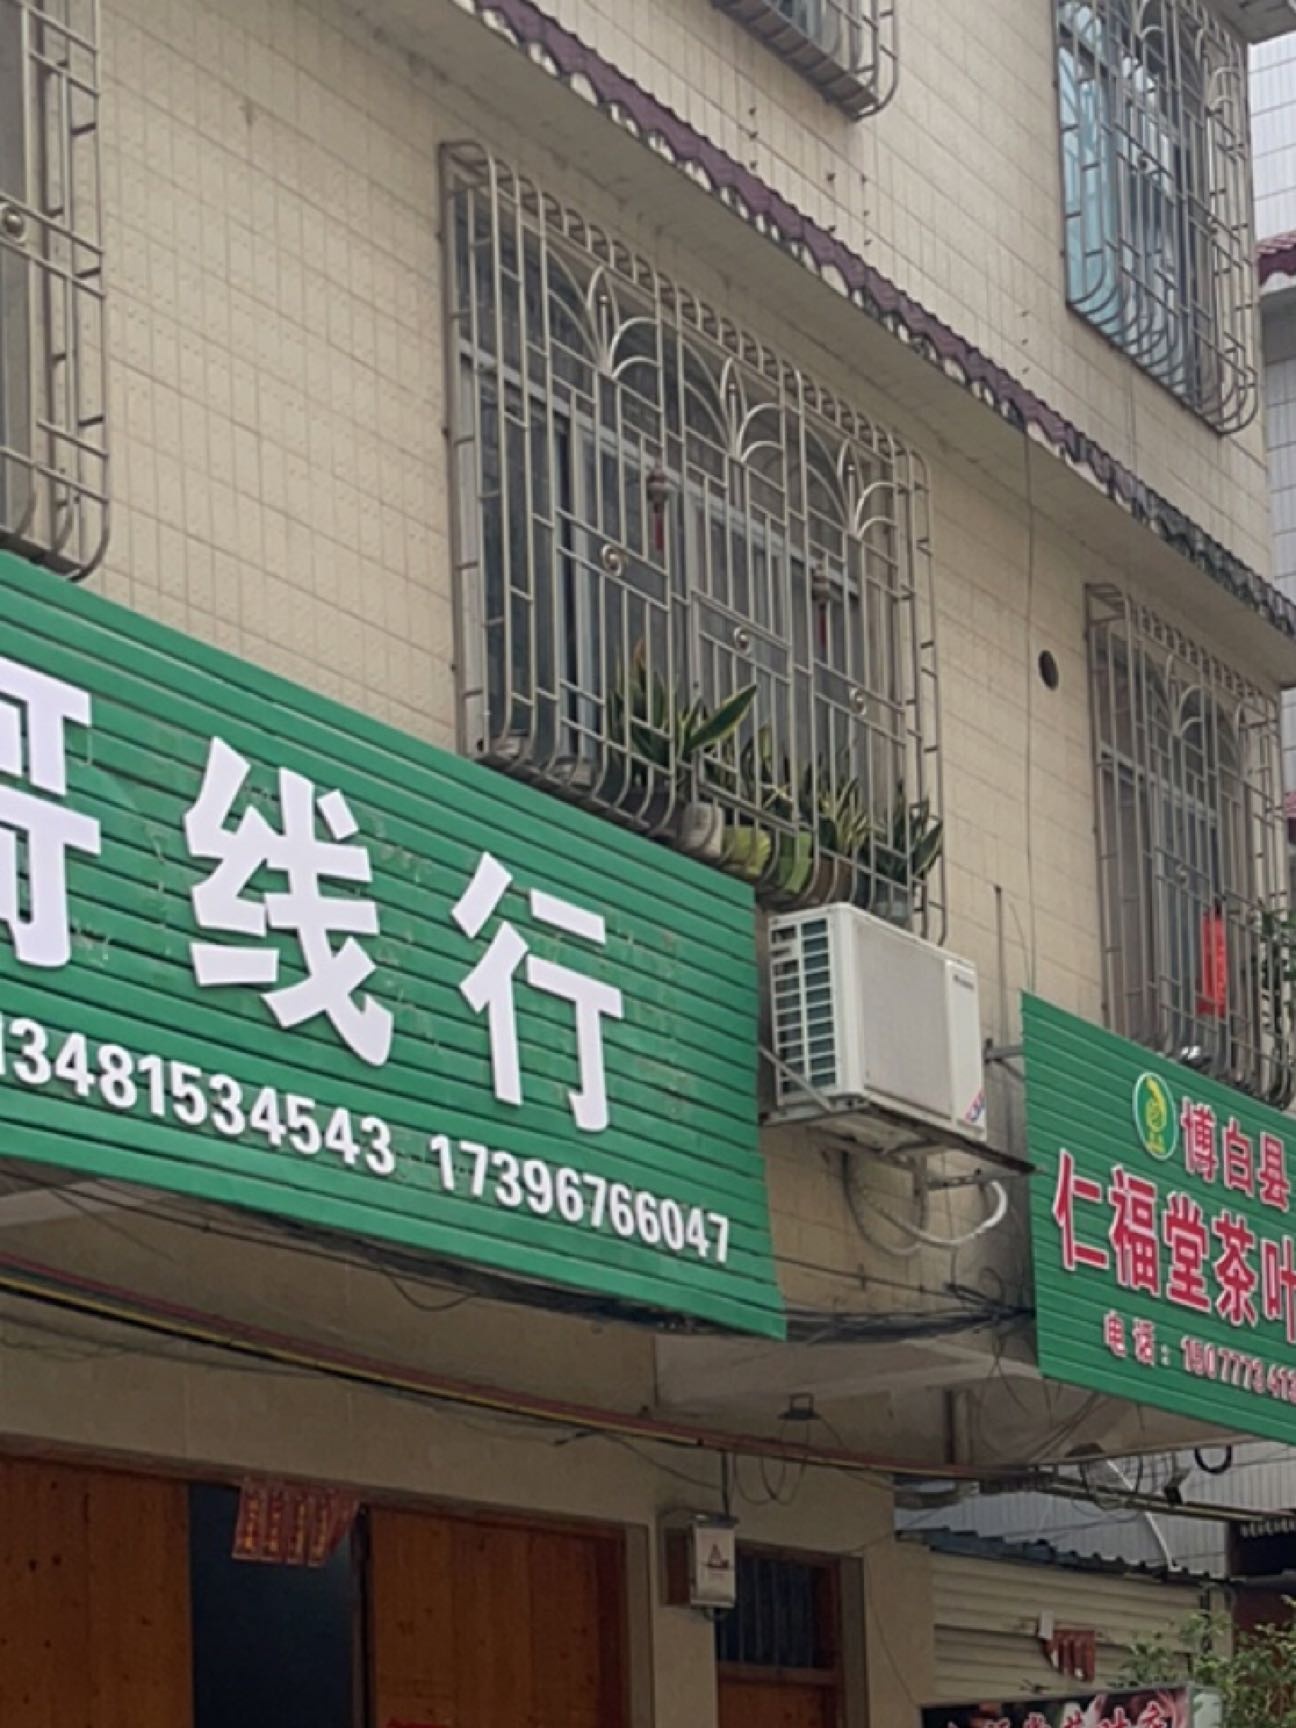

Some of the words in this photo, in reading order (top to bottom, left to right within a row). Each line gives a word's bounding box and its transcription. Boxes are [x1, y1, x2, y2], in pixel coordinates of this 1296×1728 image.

[430, 1134, 730, 1264] 17396766047
[1181, 1096, 1291, 1212] 博白县
